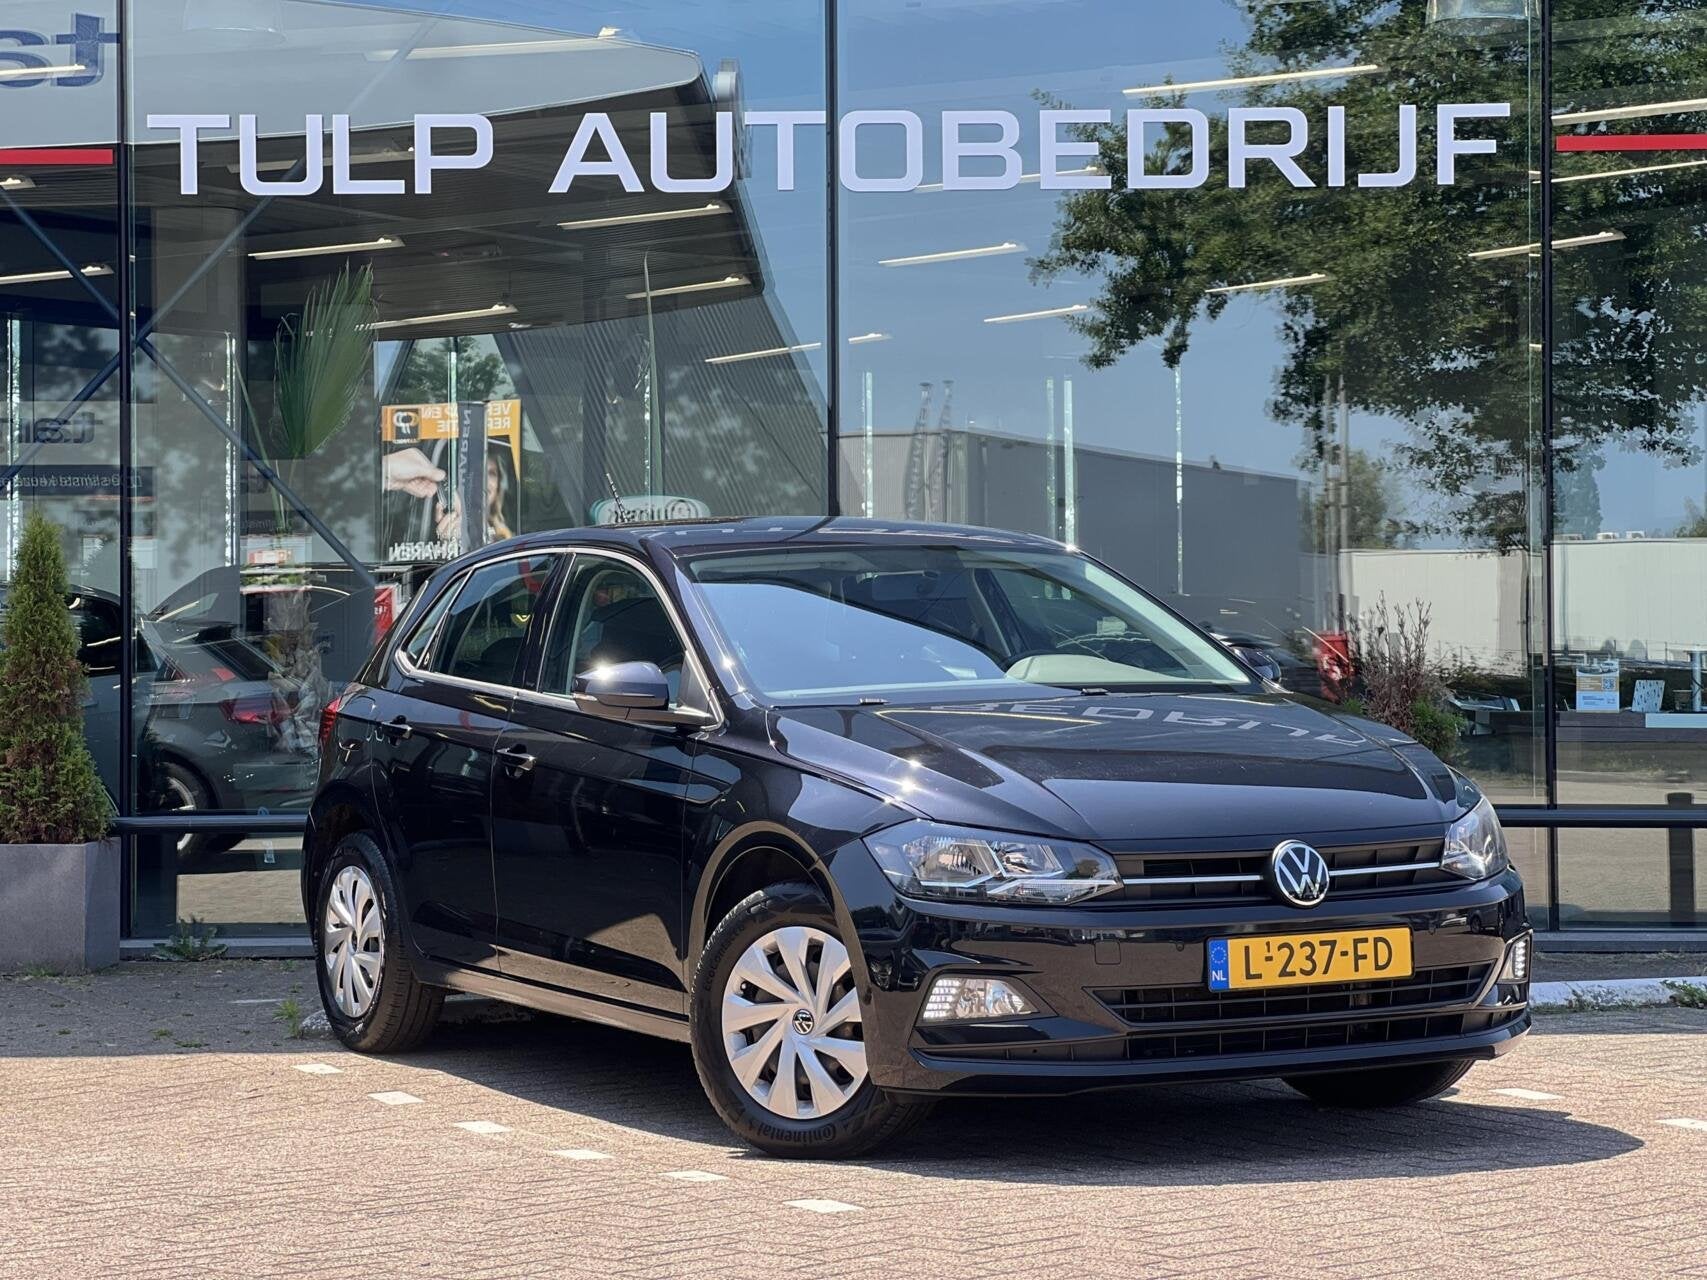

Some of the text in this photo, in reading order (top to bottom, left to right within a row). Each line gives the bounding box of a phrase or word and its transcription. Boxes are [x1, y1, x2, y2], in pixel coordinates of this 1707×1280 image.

[147, 102, 1511, 196] TULP AUTOBEDRIJF
[1212, 970, 1227, 982] NL
